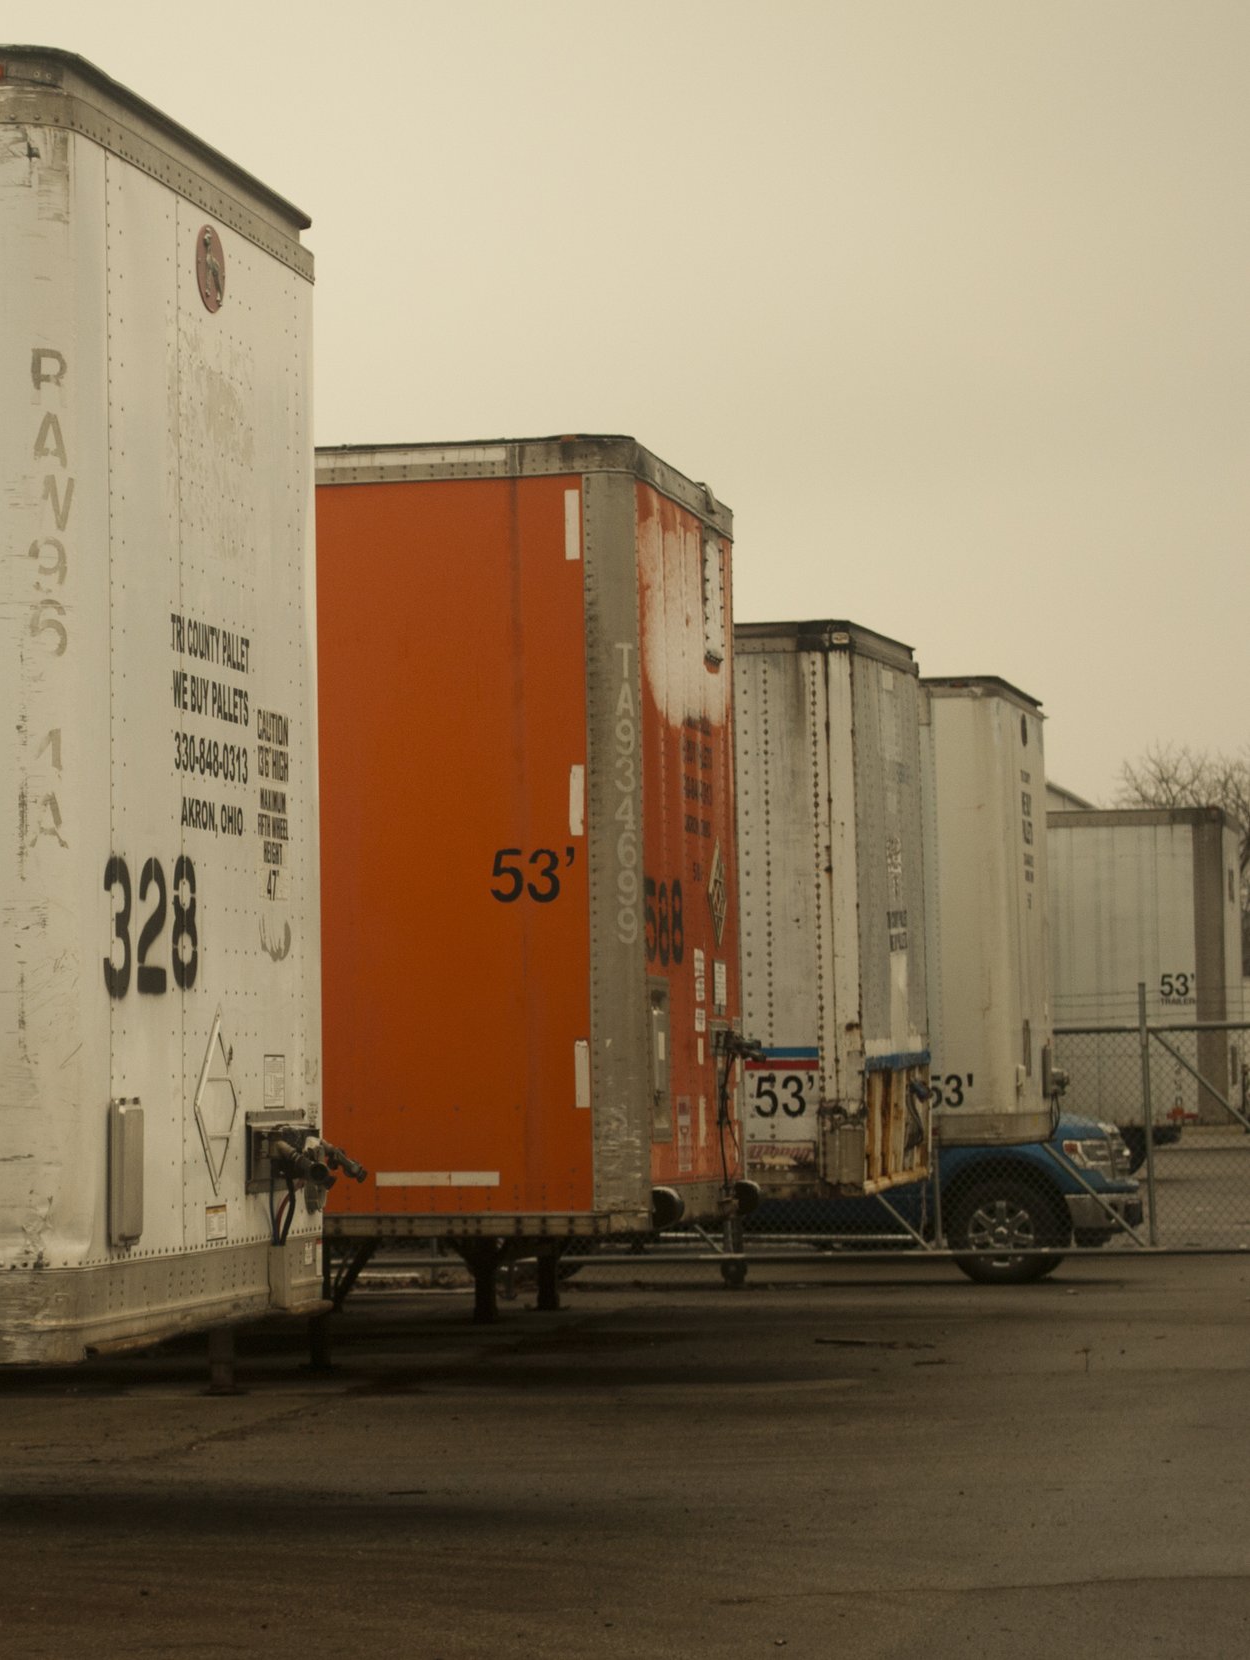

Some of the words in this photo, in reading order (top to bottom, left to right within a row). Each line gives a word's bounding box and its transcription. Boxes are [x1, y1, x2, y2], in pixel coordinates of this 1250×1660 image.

[170, 613, 185, 653] TRI
[187, 618, 221, 665] COUNTY
[222, 630, 250, 675] PALLET
[172, 670, 188, 711] WE
[190, 675, 209, 716] BUY
[212, 681, 249, 728] PALLETS
[257, 709, 289, 747] CAUTION
[174, 731, 248, 785] 330-848-0313
[272, 748, 289, 783] HIGH
[180, 796, 218, 839] AKRON,
[220, 804, 244, 837] OHIO
[103, 855, 198, 1000] 328
